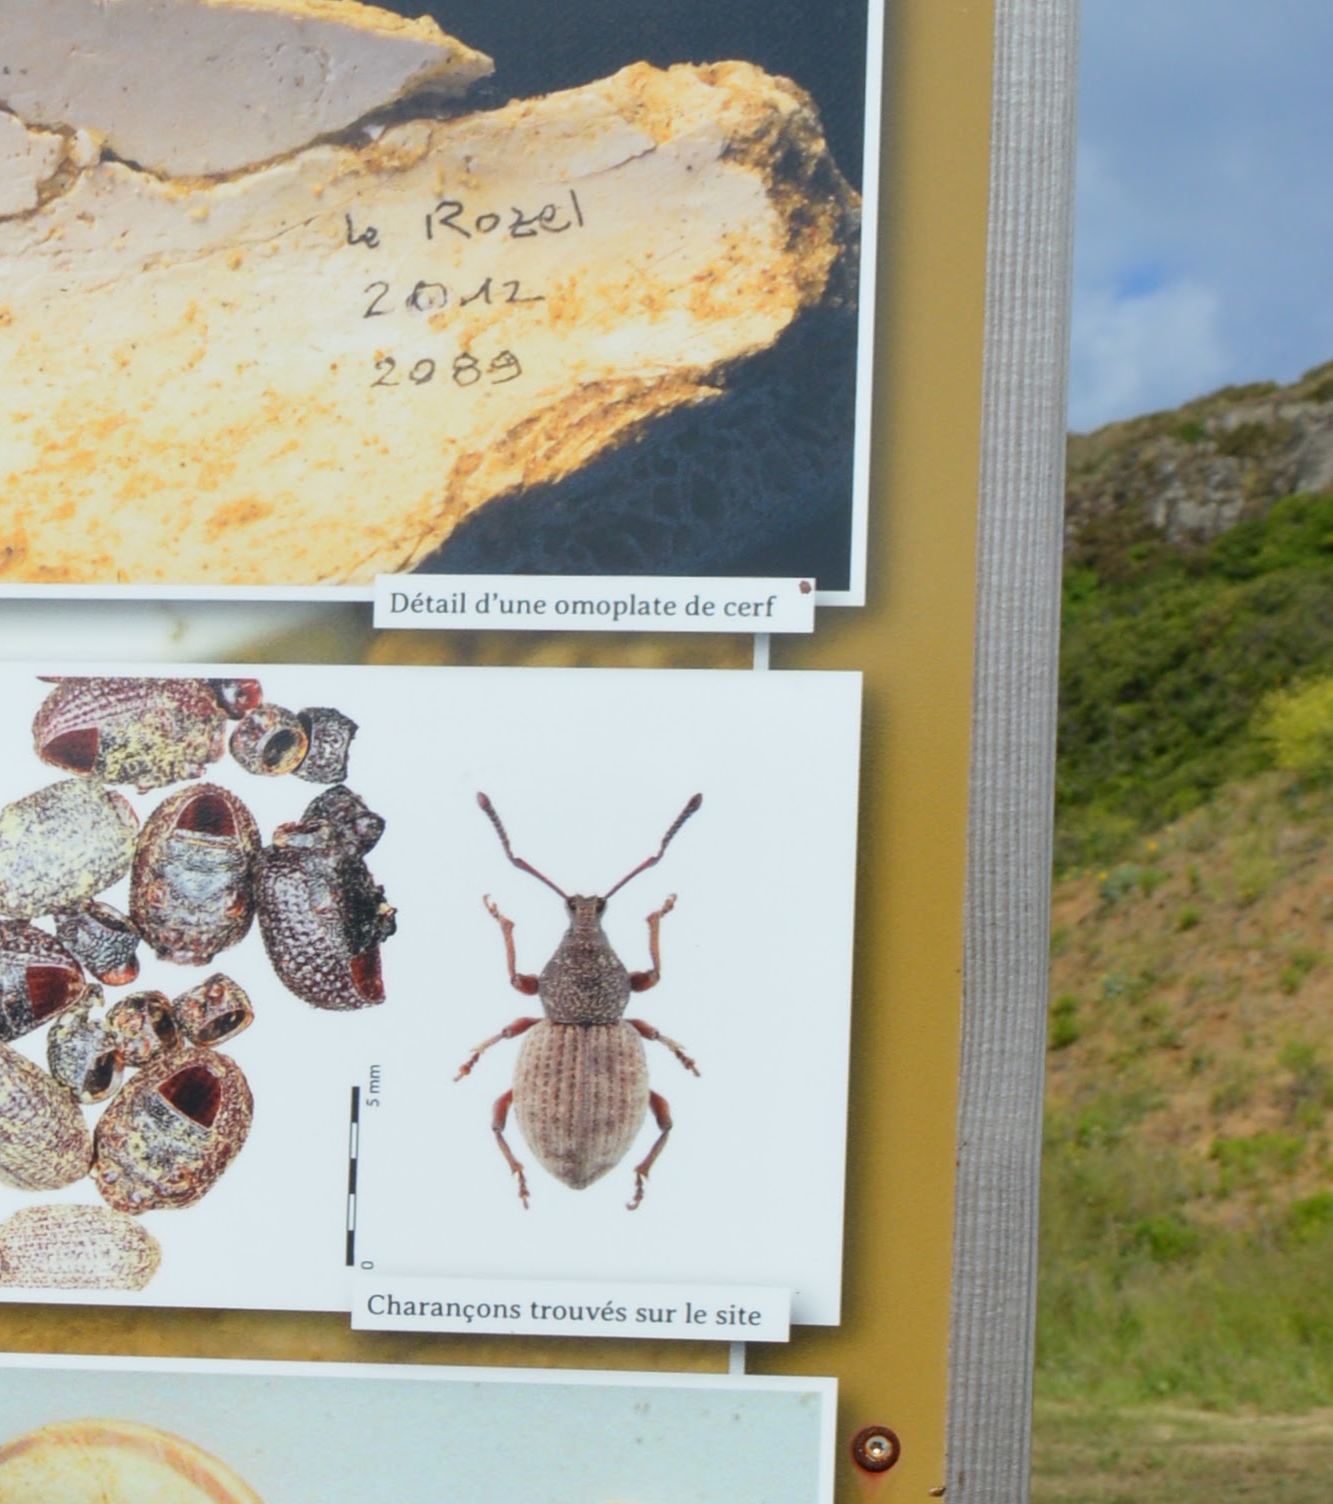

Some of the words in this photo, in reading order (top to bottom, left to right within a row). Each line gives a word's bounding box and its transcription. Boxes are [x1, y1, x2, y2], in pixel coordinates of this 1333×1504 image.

[425, 189, 587, 242] Rozel
[363, 278, 544, 319] 2012
[370, 350, 523, 389] 2089
[391, 592, 466, 614] Détail
[475, 593, 546, 614] d’une
[555, 594, 676, 622] omoplate
[685, 595, 715, 616] de
[724, 595, 777, 617] cerf
[369, 1064, 381, 1094] mm
[366, 1098, 380, 1107] 5
[361, 1260, 374, 1270] 0
[367, 1294, 521, 1323] Charançons
[531, 1301, 627, 1322] trouvés
[635, 1308, 677, 1323] sur
[685, 1302, 707, 1324] le
[716, 1304, 761, 1326] site
